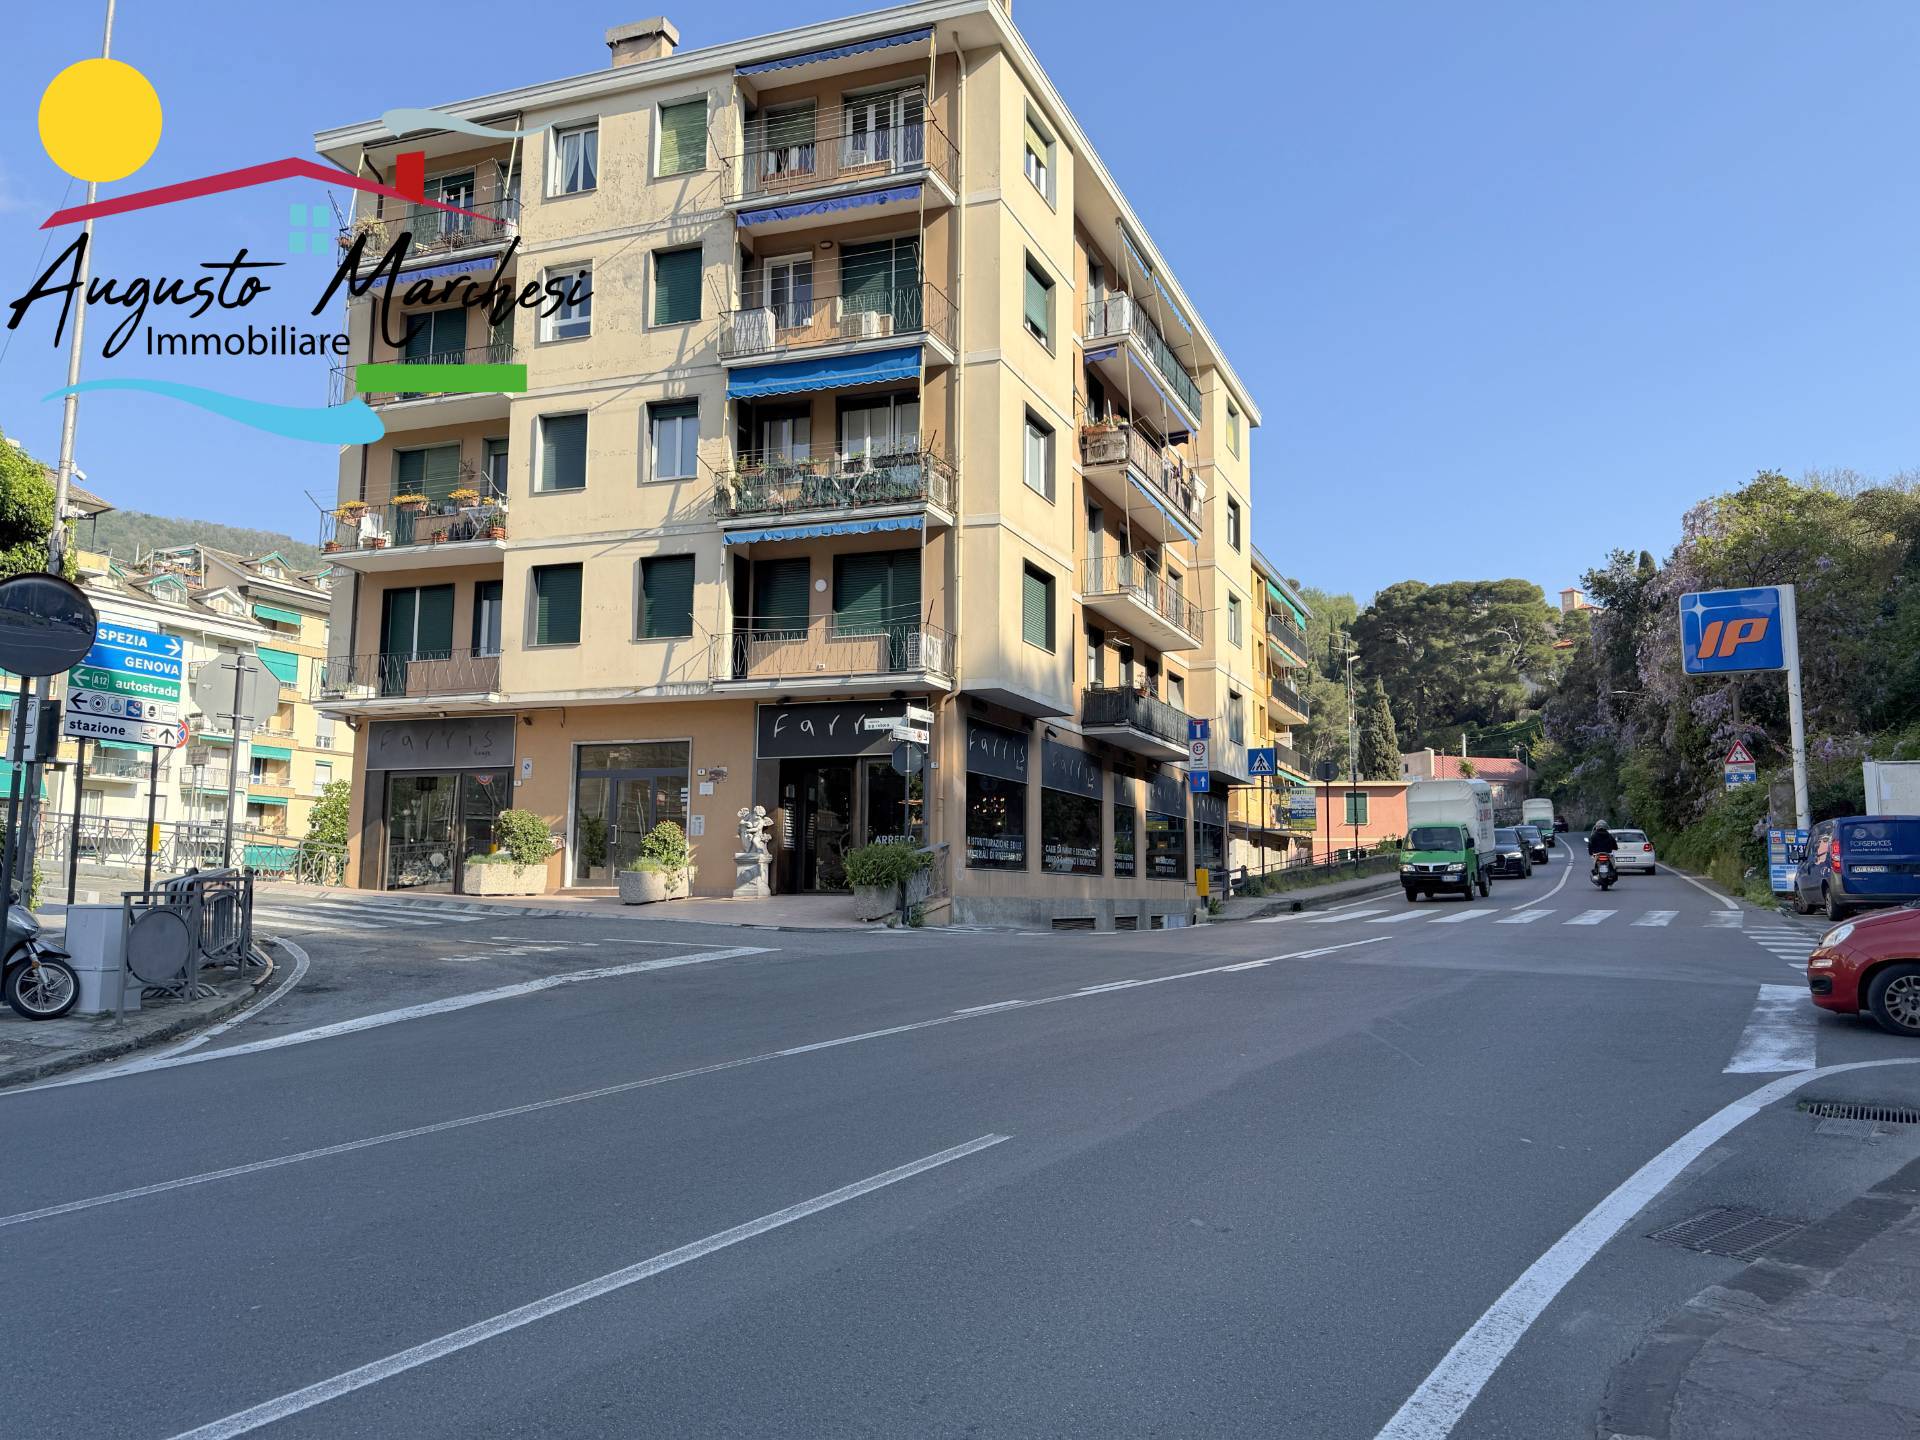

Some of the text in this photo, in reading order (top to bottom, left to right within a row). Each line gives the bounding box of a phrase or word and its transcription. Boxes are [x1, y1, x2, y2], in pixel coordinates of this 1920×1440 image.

[97, 628, 148, 648] SPEZIA
[1696, 617, 1769, 660] IP
[124, 656, 180, 676] GENOVA
[93, 675, 178, 698] A12 autostrada
[69, 719, 126, 736] stazione
[380, 727, 494, 752] Farris
[968, 728, 1025, 763] Farris
